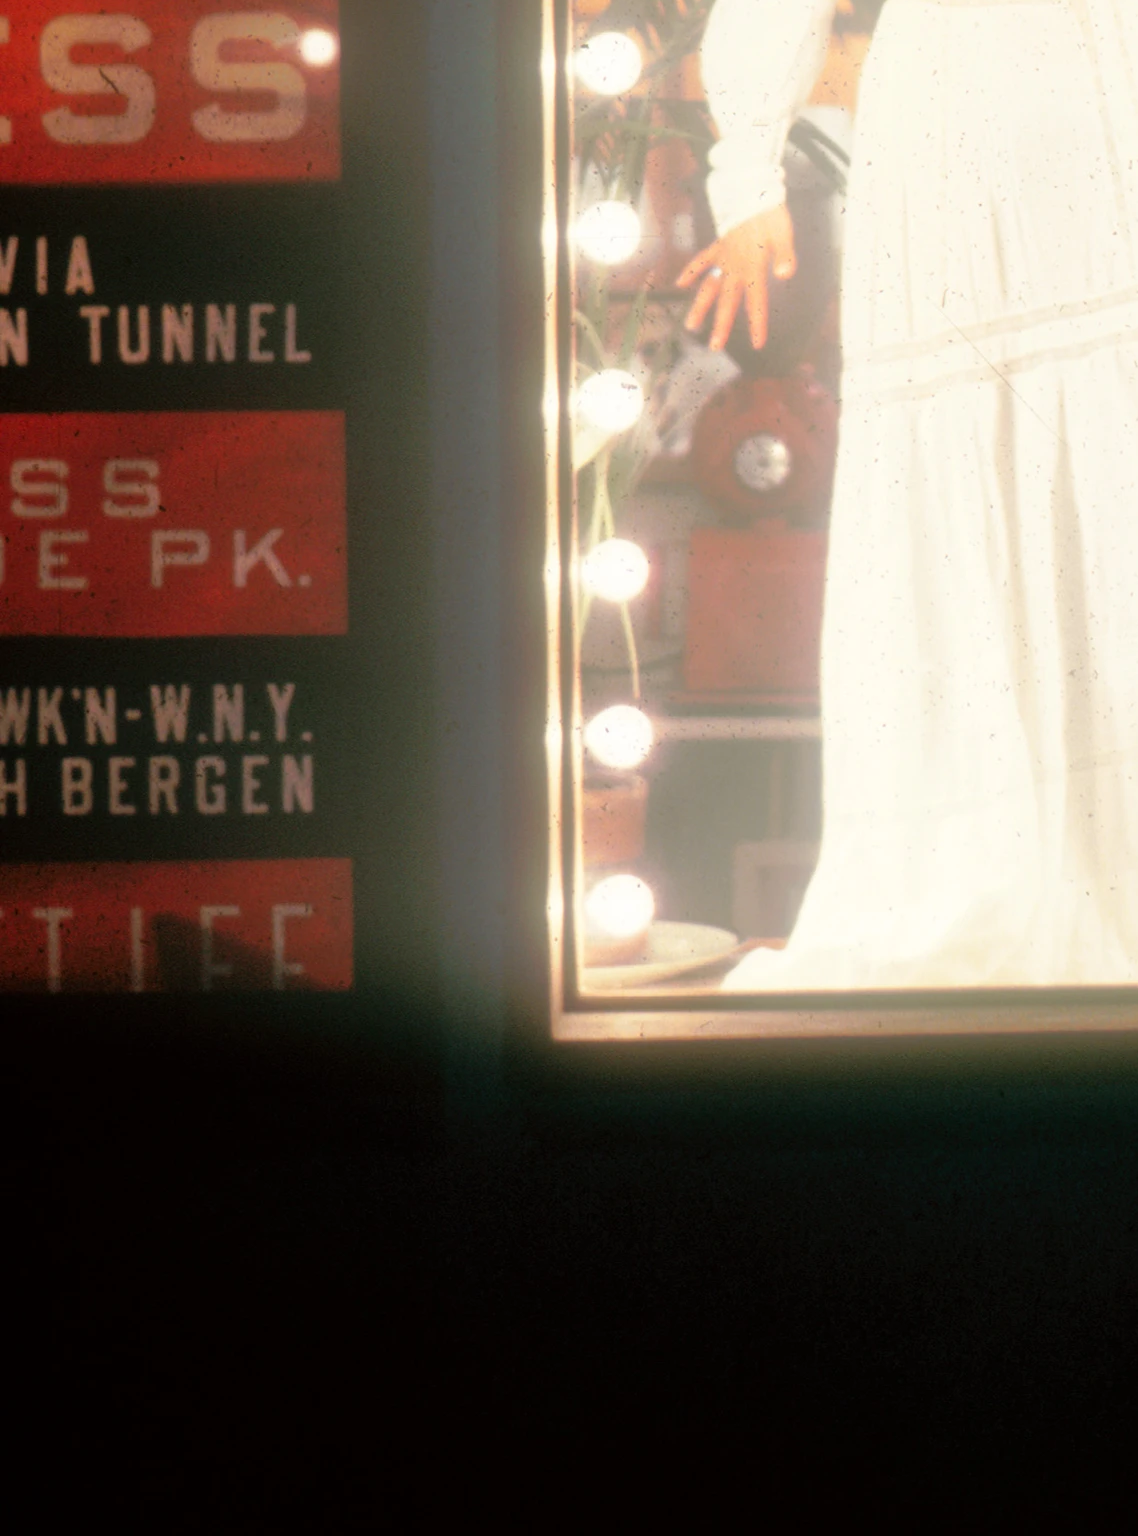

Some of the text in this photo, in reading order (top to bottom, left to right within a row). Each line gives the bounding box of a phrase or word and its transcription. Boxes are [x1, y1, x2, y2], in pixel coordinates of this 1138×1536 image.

[0, 12, 307, 144] SS
[79, 303, 312, 365] TUNNEL
[10, 459, 161, 518] SS
[151, 527, 312, 588] PK.
[61, 754, 315, 815] BERGEN
